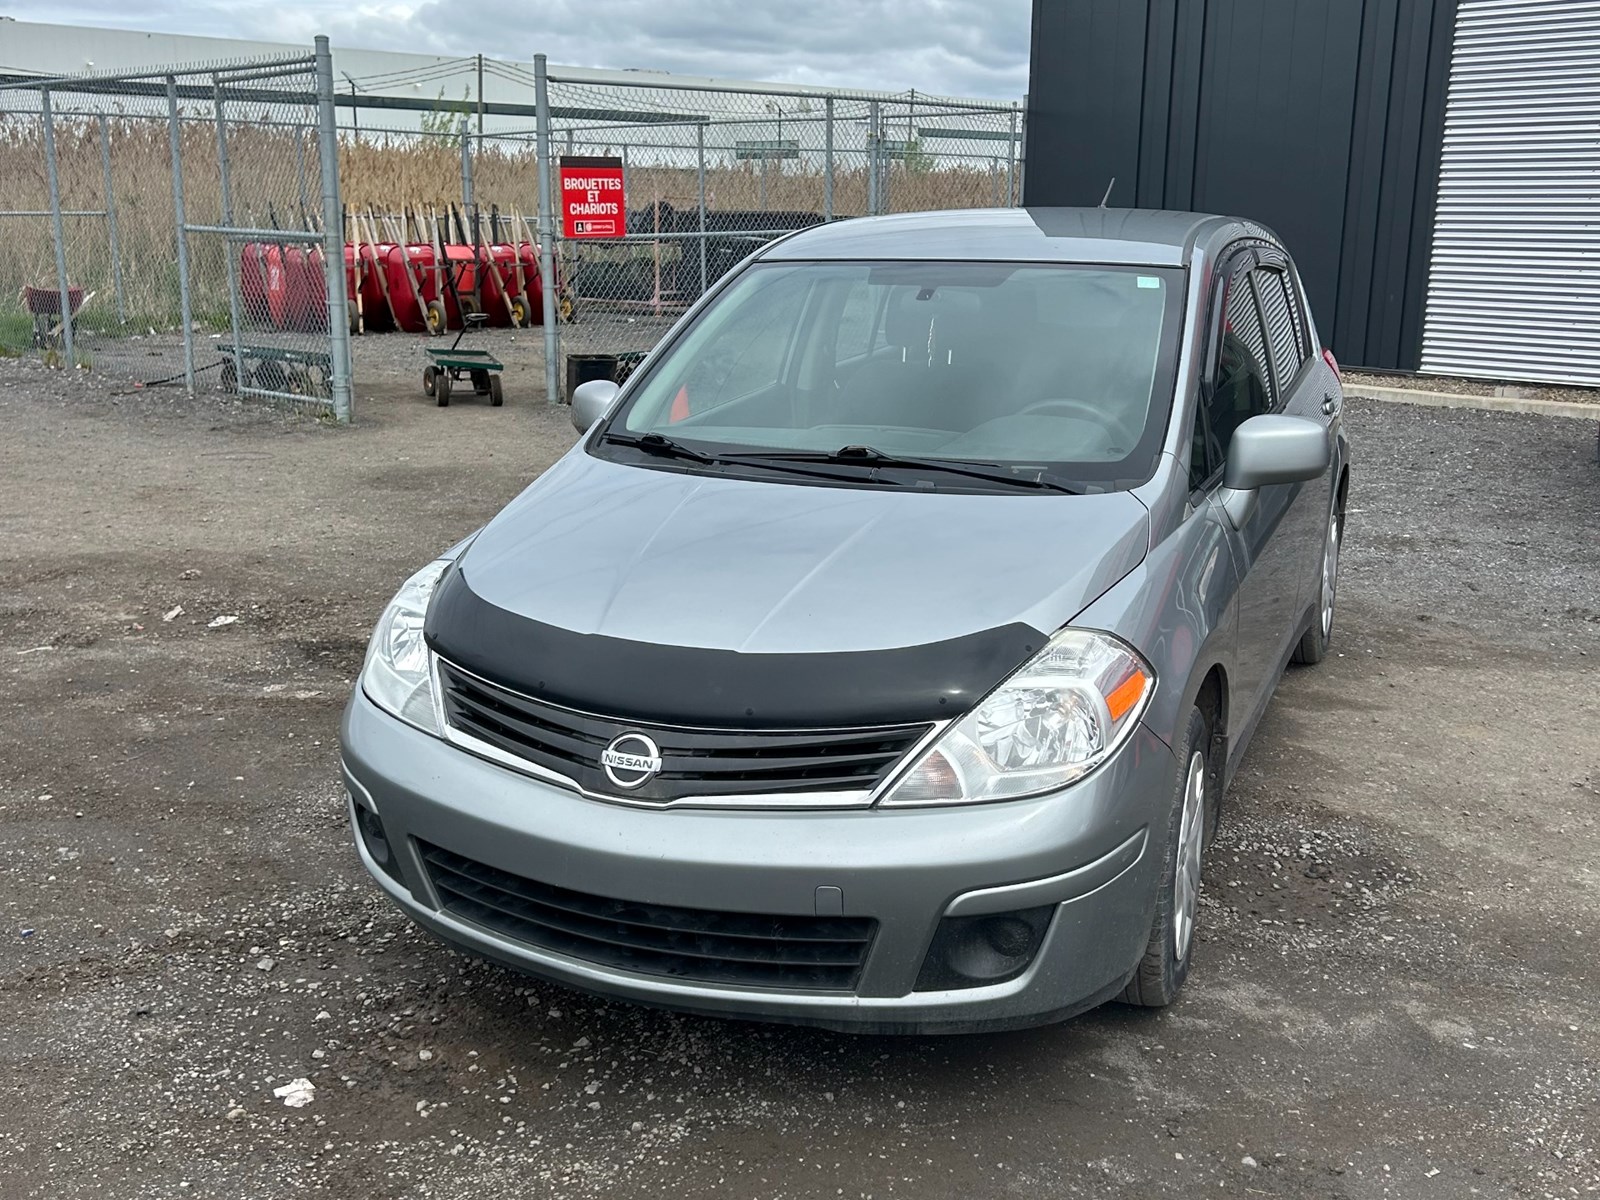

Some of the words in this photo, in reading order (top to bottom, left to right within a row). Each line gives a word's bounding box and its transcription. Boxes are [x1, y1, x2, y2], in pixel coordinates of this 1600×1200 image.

[564, 177, 622, 190] BROUETTES
[587, 190, 600, 203] ET
[569, 203, 619, 215] CHARIOTS
[604, 753, 654, 769] NISSAN
